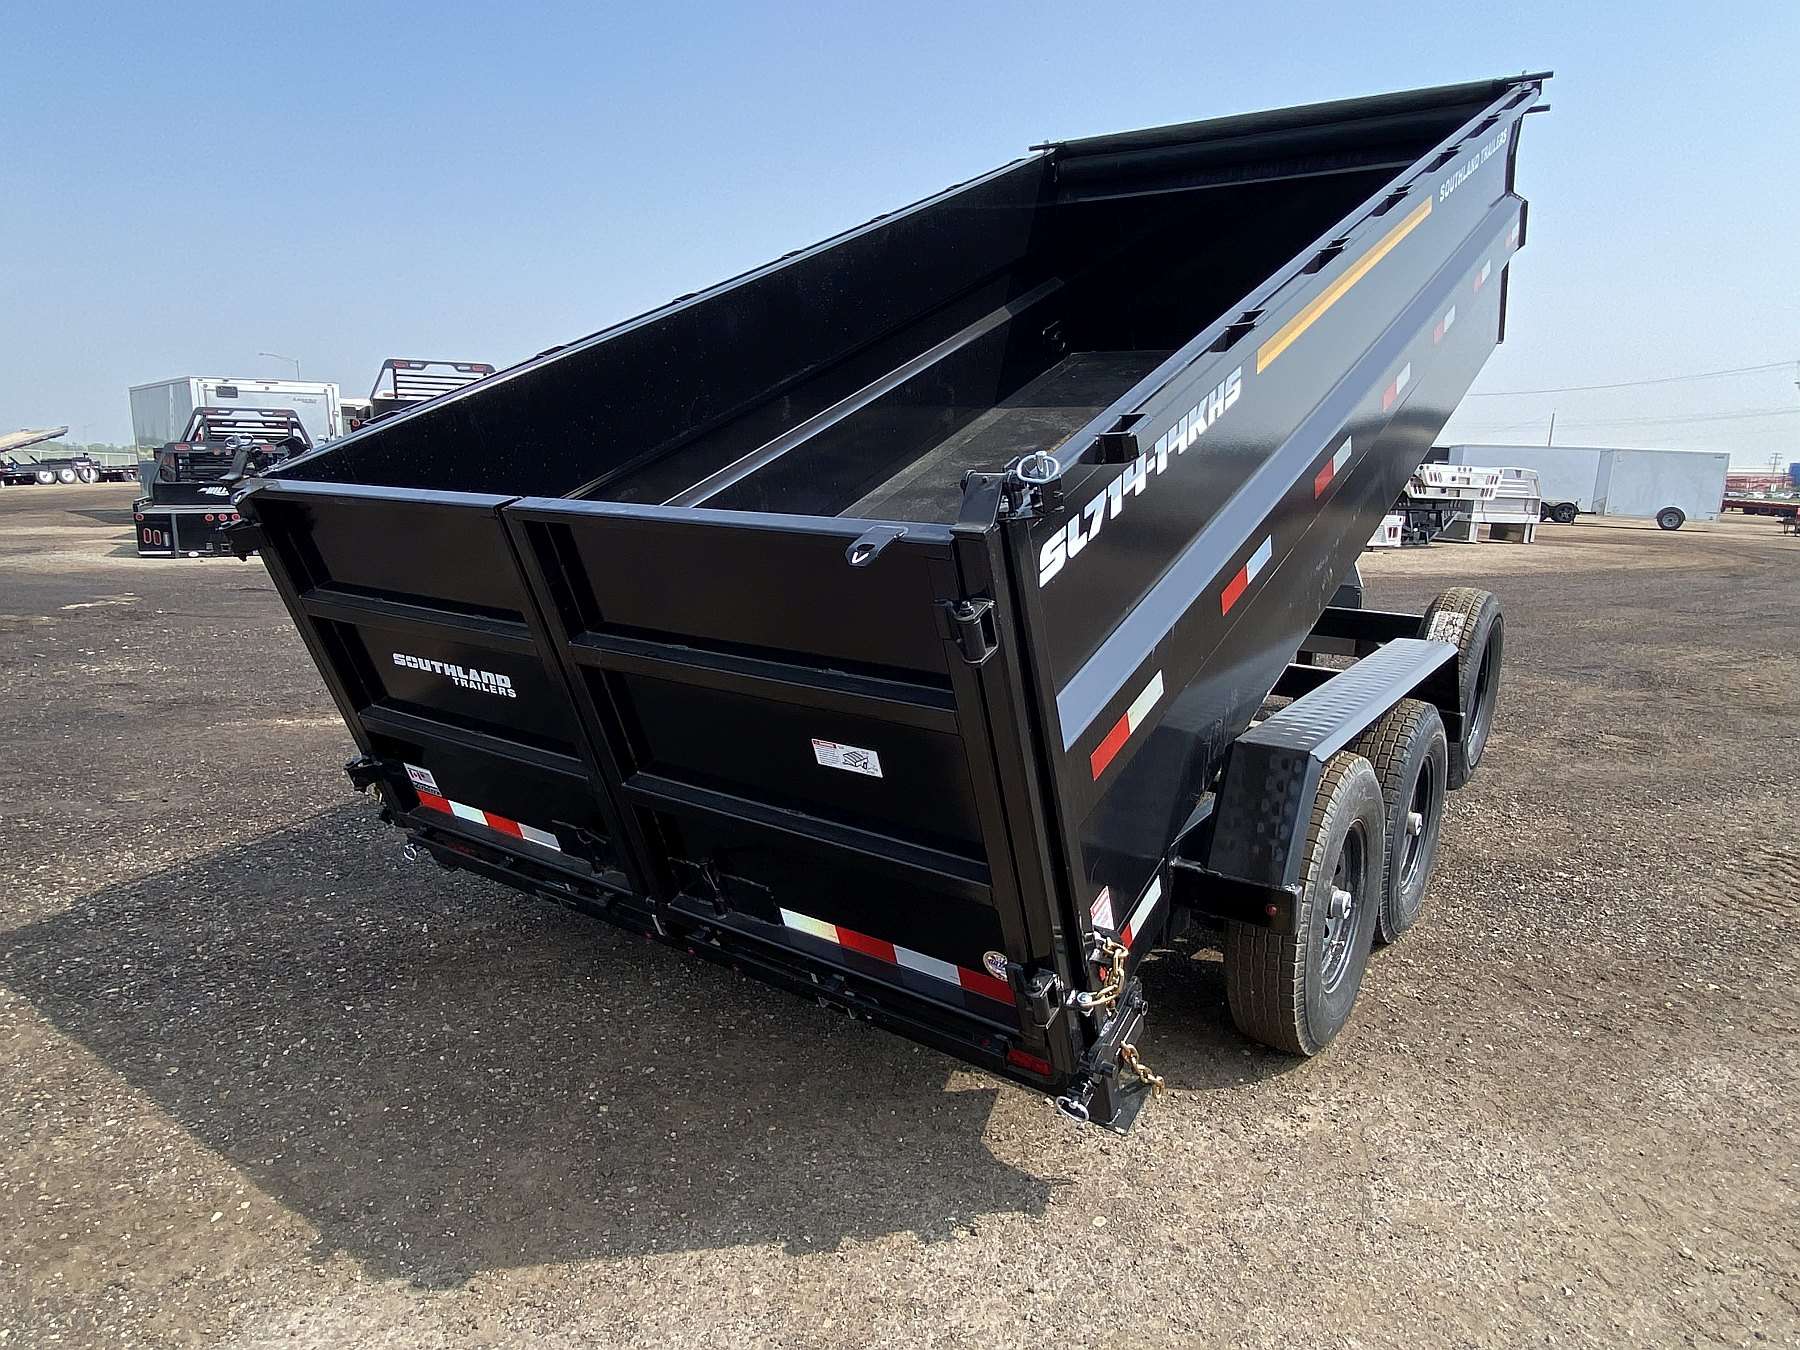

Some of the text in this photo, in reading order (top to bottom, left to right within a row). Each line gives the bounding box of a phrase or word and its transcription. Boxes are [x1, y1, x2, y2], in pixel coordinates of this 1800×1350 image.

[1439, 127, 1507, 203] SOUTHLAND TRAILERS
[1039, 366, 1242, 588] SL714-14KHS
[392, 653, 512, 688] SOUTHLAND
[452, 676, 517, 698] TRAILERS
